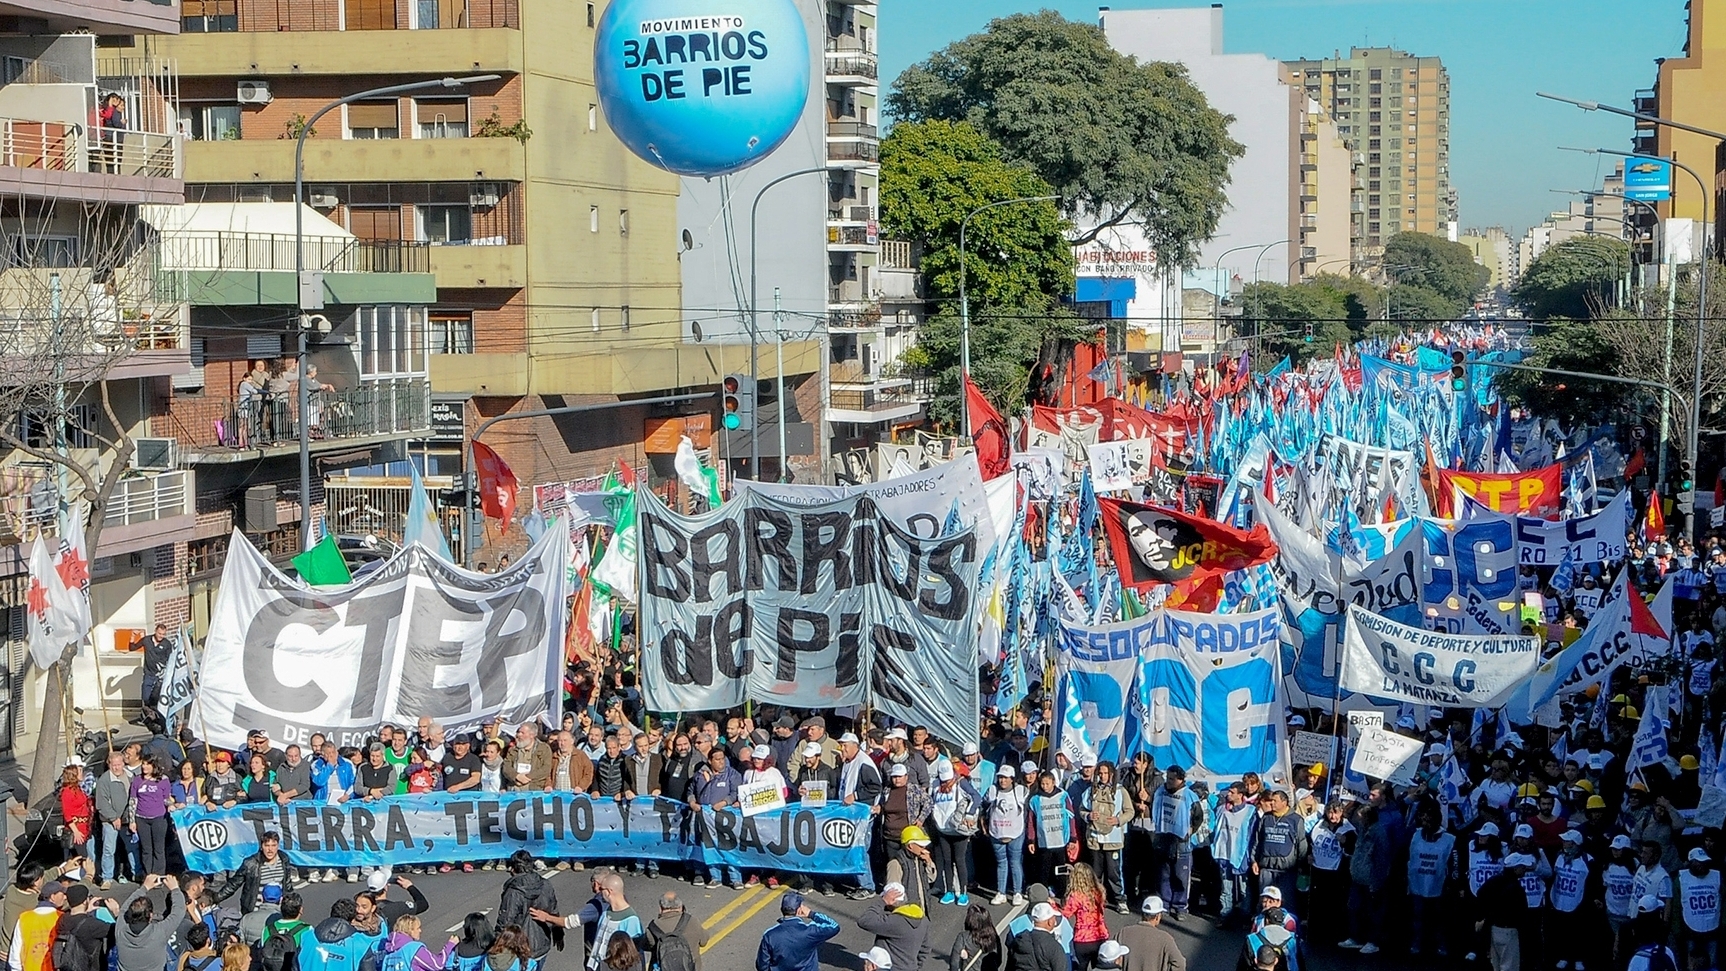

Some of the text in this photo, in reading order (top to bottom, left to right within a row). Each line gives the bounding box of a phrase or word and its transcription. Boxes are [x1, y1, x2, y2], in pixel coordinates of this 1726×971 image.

[641, 17, 743, 34] MOVIMIENTO
[623, 30, 769, 69] BARRIOS
[641, 65, 752, 102] DE PIE
[641, 496, 978, 621] BARRIOS
[1171, 541, 1217, 570] JCR
[1596, 541, 1621, 560] Bis
[1353, 609, 1533, 655] COMISION DE DEPORTE Y CULTURA
[242, 584, 547, 720] CTEP
[1382, 676, 1461, 705] LA MATANZA
[283, 724, 309, 745] DE
[1350, 715, 1382, 726] BASTA
[241, 805, 434, 853] TIERRA,
[443, 795, 596, 846] TECHO
[618, 799, 635, 839] Y
[1689, 894, 1717, 910] CCC
